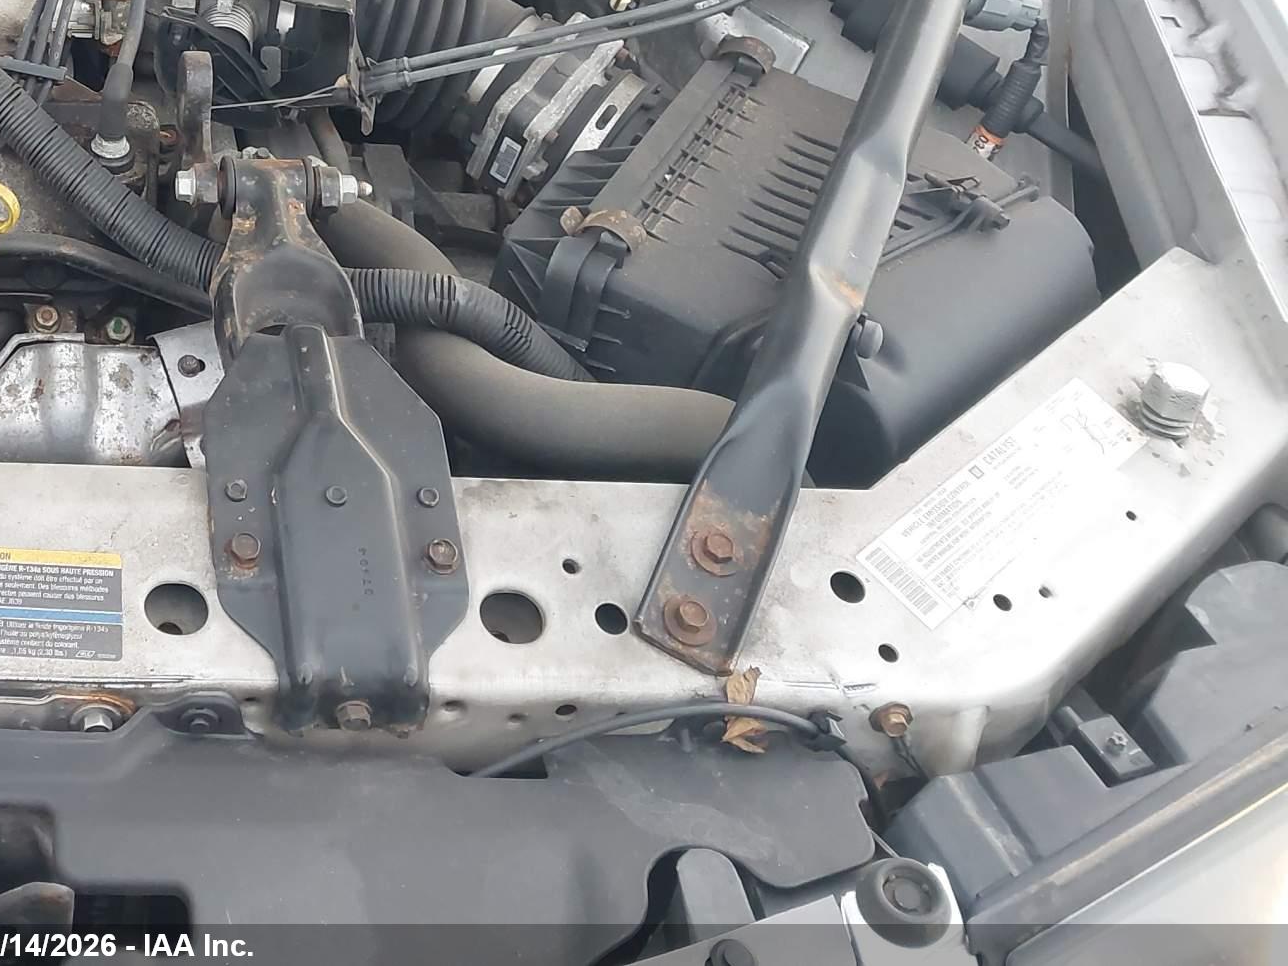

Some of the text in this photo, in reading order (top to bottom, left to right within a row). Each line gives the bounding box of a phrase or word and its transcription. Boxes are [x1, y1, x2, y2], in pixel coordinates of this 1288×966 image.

[982, 435, 1017, 466] CATALYST
[18, 565, 40, 573] R-134a
[42, 566, 59, 574] SOUS
[60, 567, 80, 575] HAUTE
[82, 569, 113, 577] PRESSION
